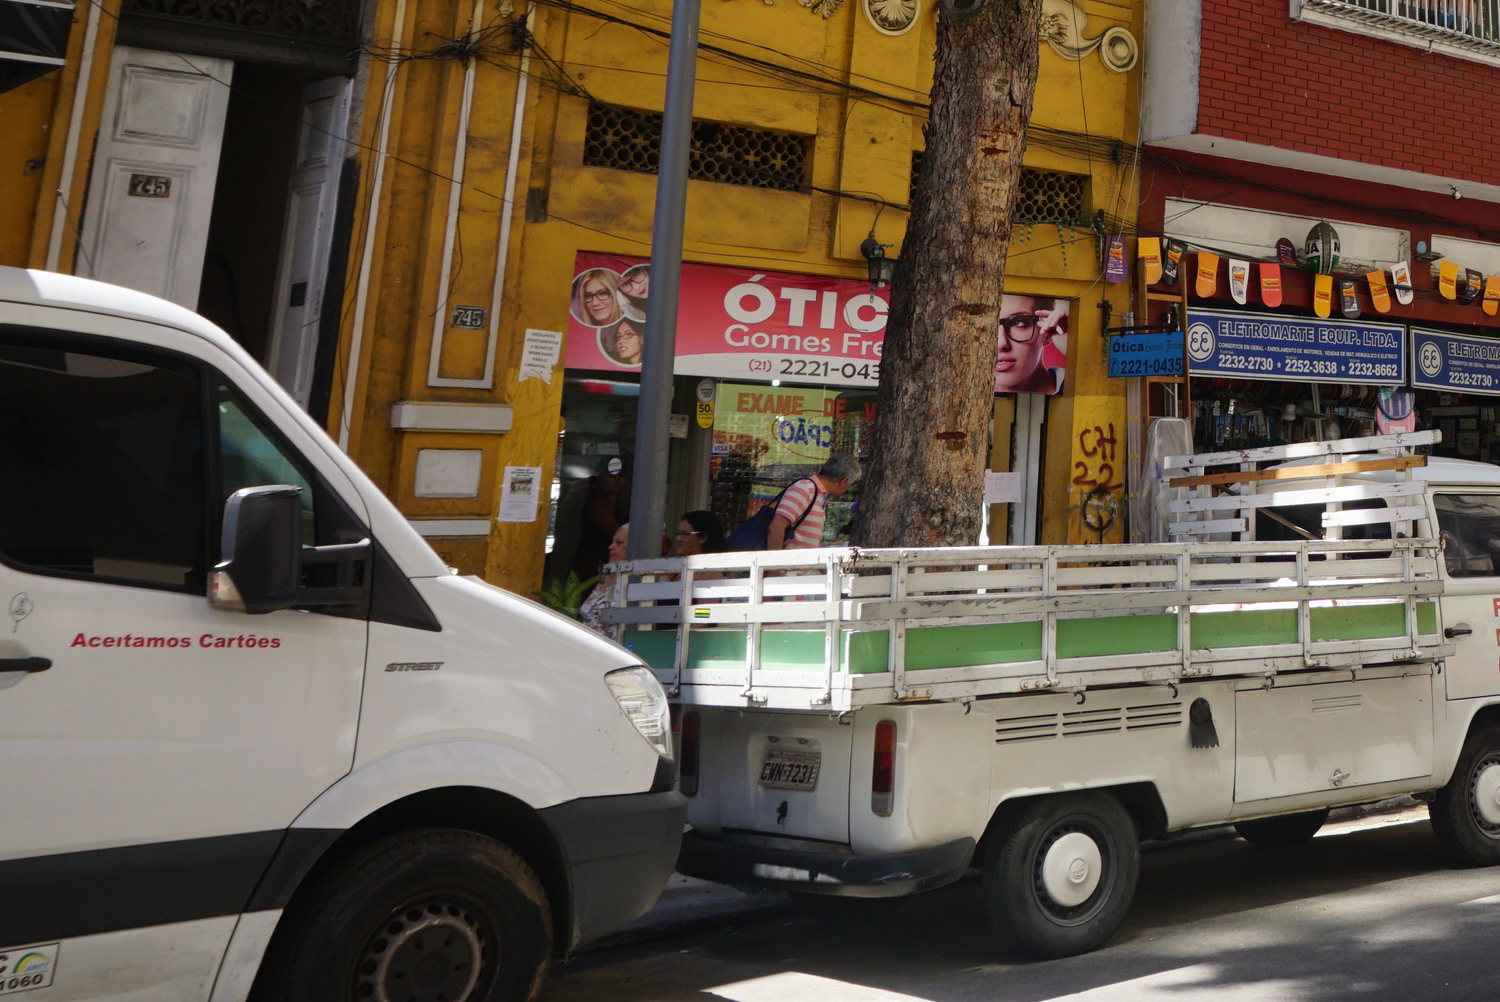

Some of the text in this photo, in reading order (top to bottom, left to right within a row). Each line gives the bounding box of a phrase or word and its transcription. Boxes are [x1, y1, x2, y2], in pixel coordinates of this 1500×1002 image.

[134, 178, 170, 196] 745
[456, 308, 482, 326] 745
[724, 324, 831, 353] Gomes
[1218, 320, 1398, 348] ELETROMARTE EQUIP. LTDA.
[1112, 338, 1145, 353] Ótica
[749, 359, 772, 373] (21)
[1120, 358, 1182, 375] 2221-0435
[1218, 354, 1398, 377] 2232-2730 2252-3638 2232-8662
[1449, 371, 1492, 387] 2232-2730
[737, 393, 804, 415] EXAME
[823, 398, 847, 418] DE
[71, 633, 281, 649] Aceitamos Cartões
[384, 662, 444, 673] STREET
